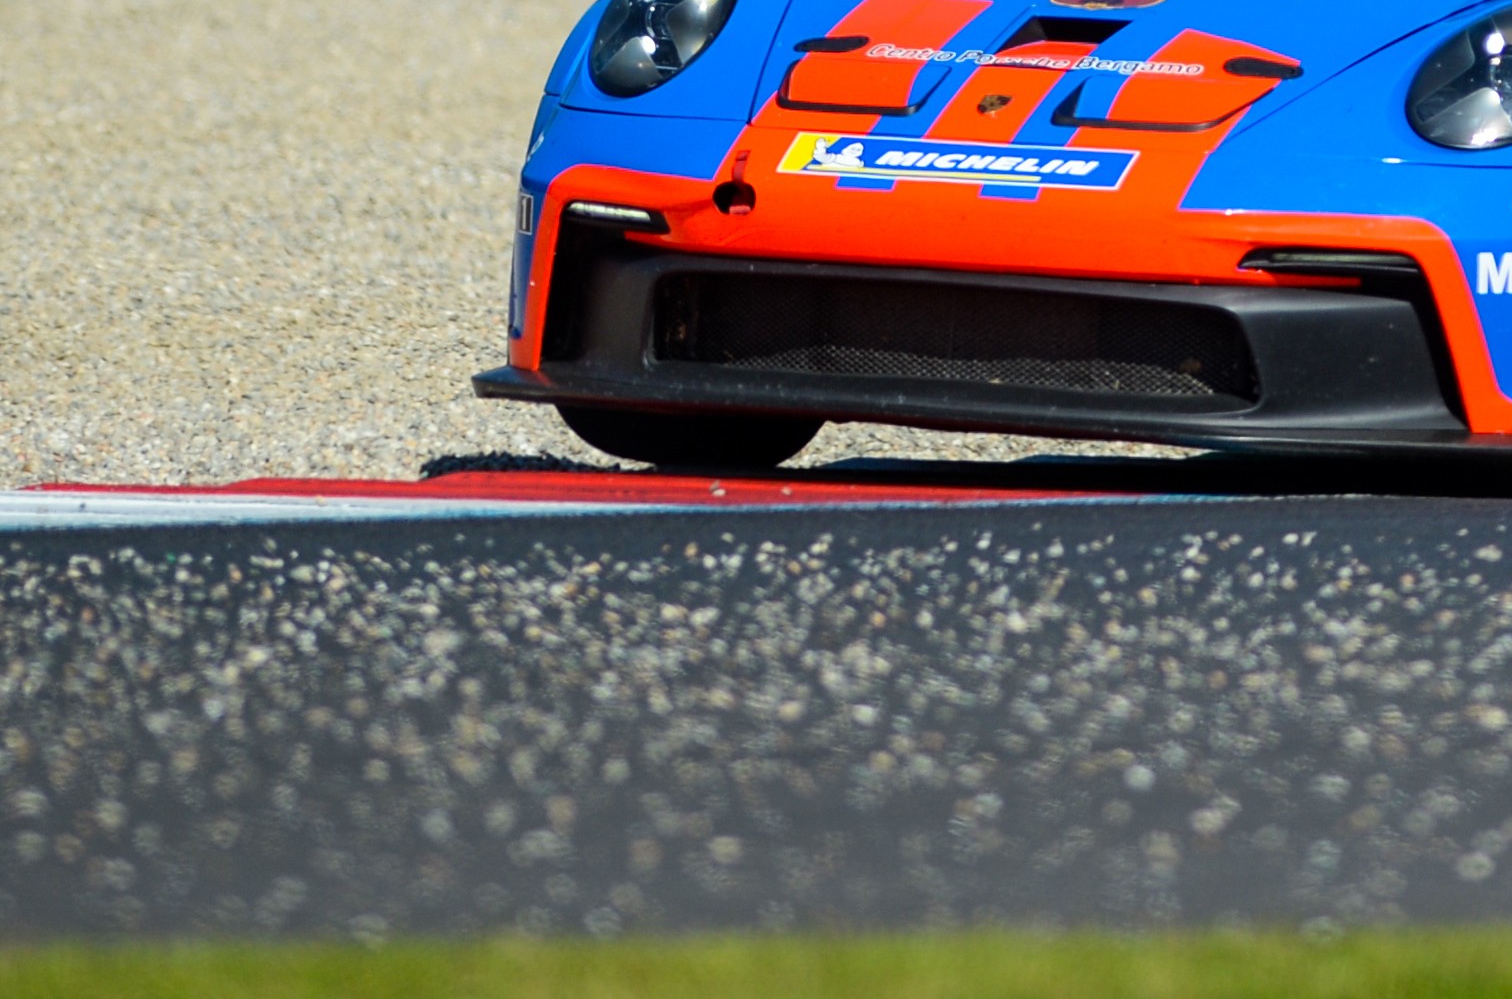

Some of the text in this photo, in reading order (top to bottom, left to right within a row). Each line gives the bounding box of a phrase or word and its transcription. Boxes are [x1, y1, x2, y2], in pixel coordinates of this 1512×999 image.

[866, 43, 1205, 76] Centro Porsche Bergamo
[874, 150, 1100, 176] MICHELIN
